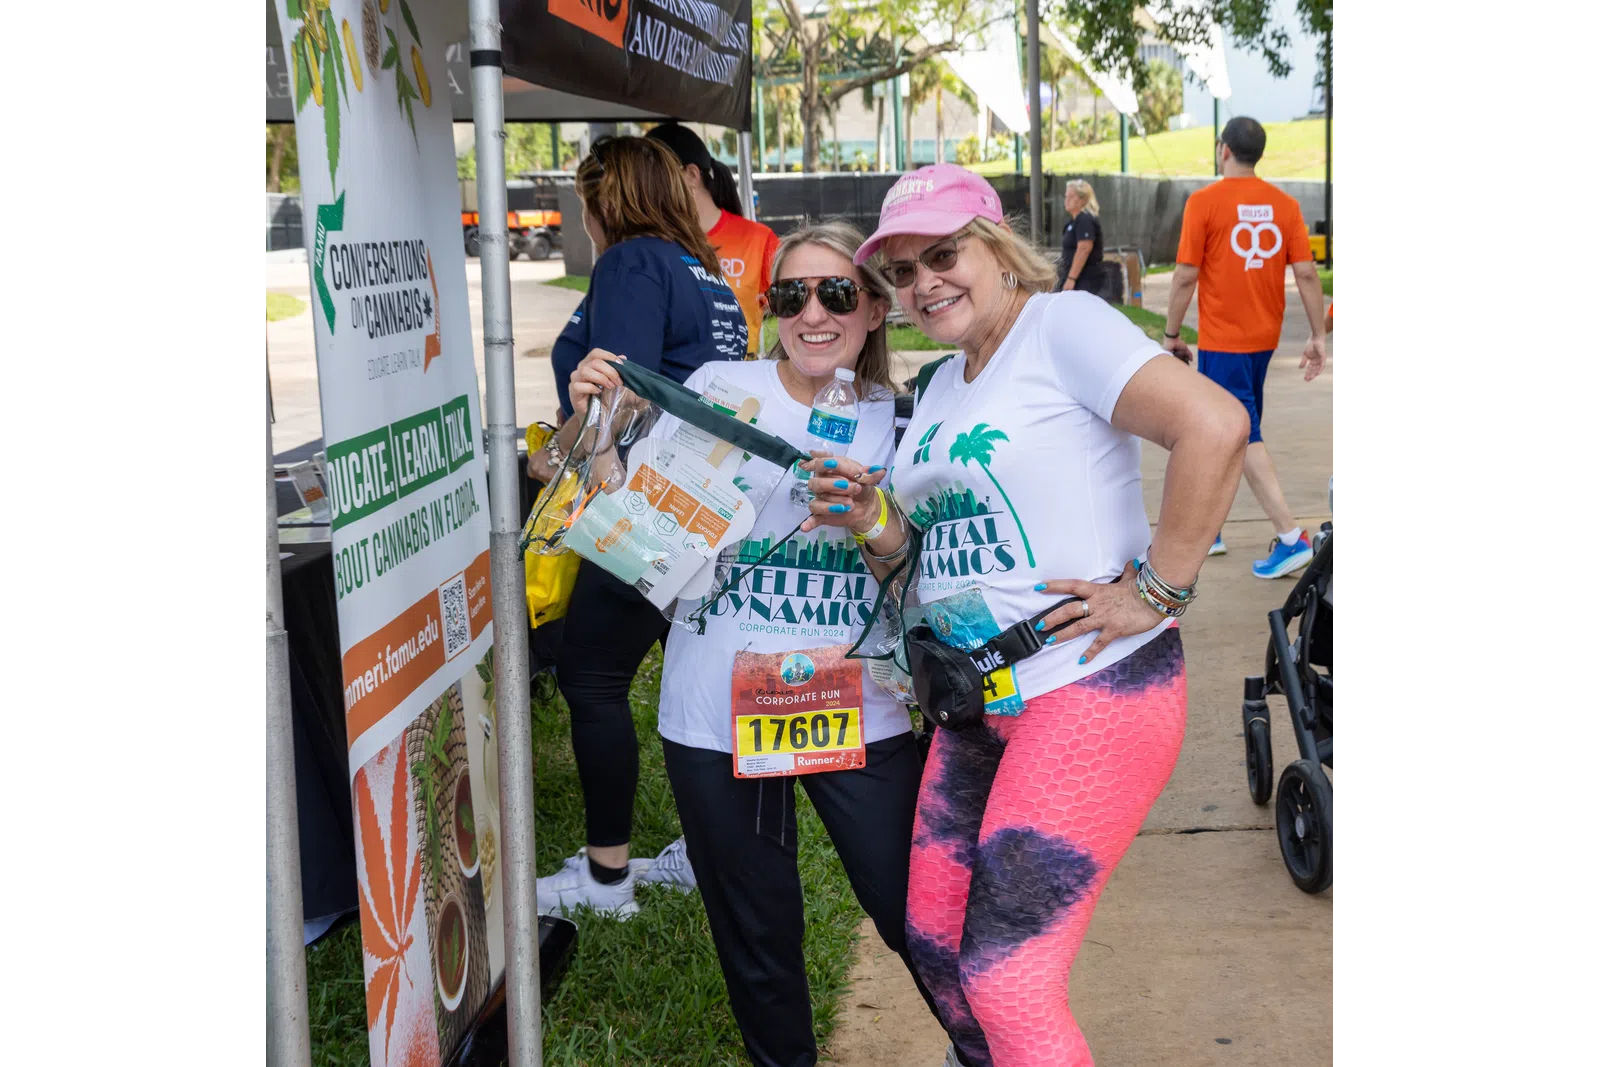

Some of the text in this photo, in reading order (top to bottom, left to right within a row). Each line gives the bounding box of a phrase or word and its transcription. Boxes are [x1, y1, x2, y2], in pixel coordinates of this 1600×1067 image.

[629, 11, 667, 63] AND
[315, 220, 327, 268] FAMU
[329, 239, 428, 291] CONVERSATIONS
[720, 257, 746, 278] RD
[351, 296, 365, 329] ON
[364, 287, 424, 340] CANNABIS
[326, 407, 473, 521] DUCATE. LEARN. TALK.
[336, 478, 480, 600] BOUT CANNABIS IN FLORIDA.
[922, 517, 1010, 552] LETAL
[920, 543, 1016, 577] AMICS
[937, 581, 953, 591] RUN
[955, 577, 977, 589] 2024
[709, 593, 880, 627] DYNAMICS
[739, 622, 844, 637] CORPORATE RUN 2024
[755, 689, 840, 706] CORPORATE RUN
[749, 712, 849, 752] 17607
[797, 756, 835, 767] Runner
